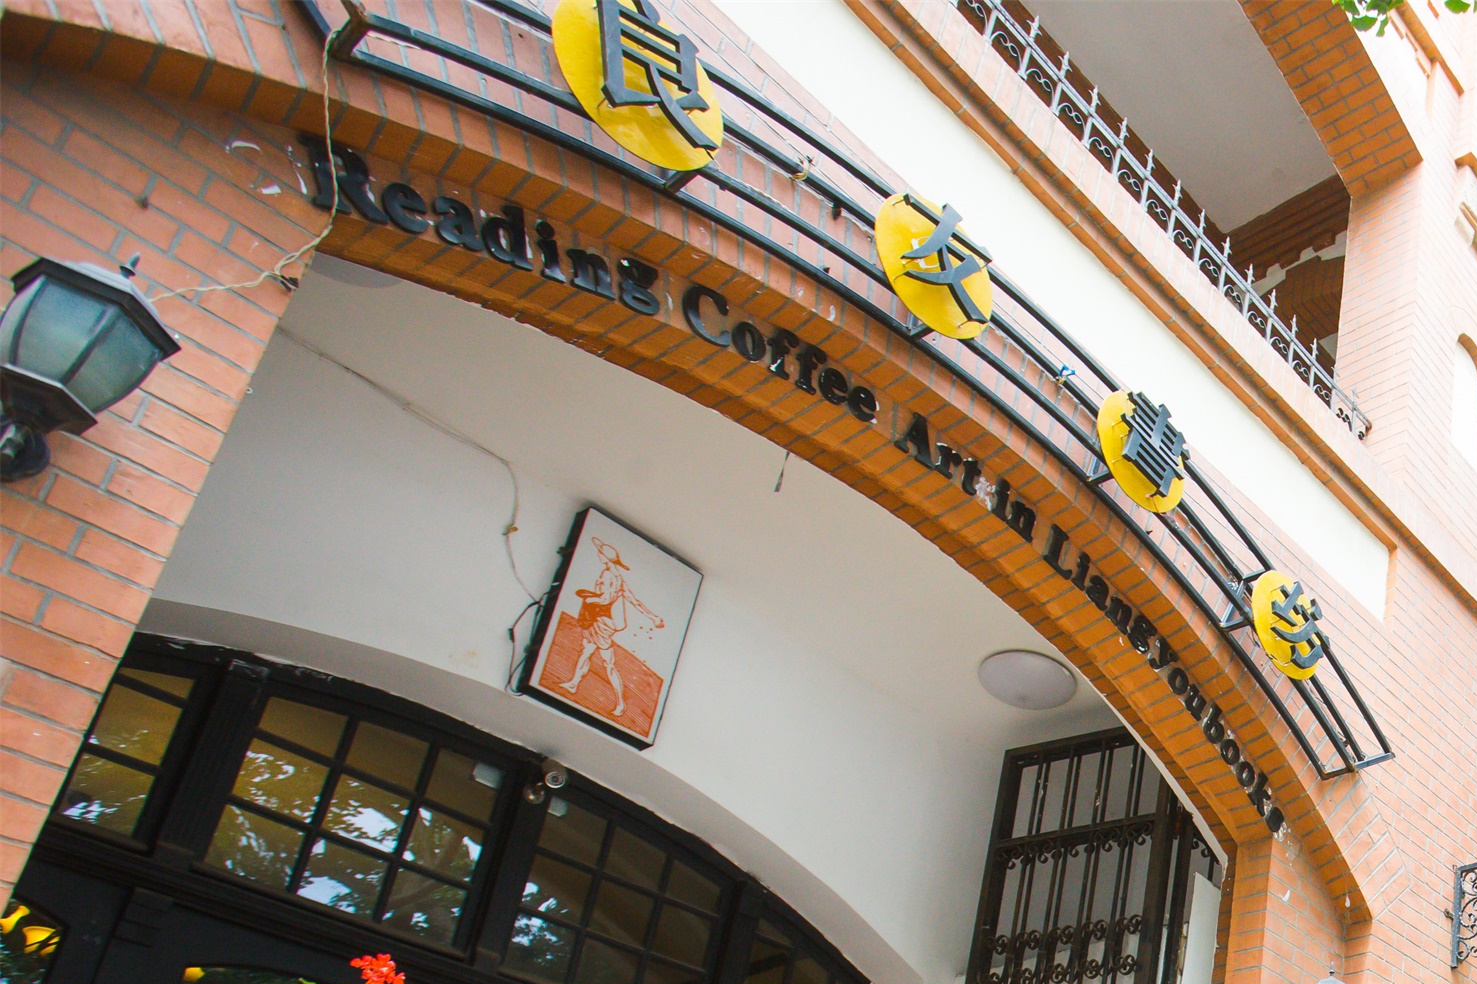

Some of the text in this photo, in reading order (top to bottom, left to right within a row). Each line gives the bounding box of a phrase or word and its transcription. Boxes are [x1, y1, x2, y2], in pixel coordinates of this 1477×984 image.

[296, 131, 660, 317] Reading
[682, 284, 879, 423] Coffee
[894, 412, 982, 496] Art
[990, 478, 1037, 543] in
